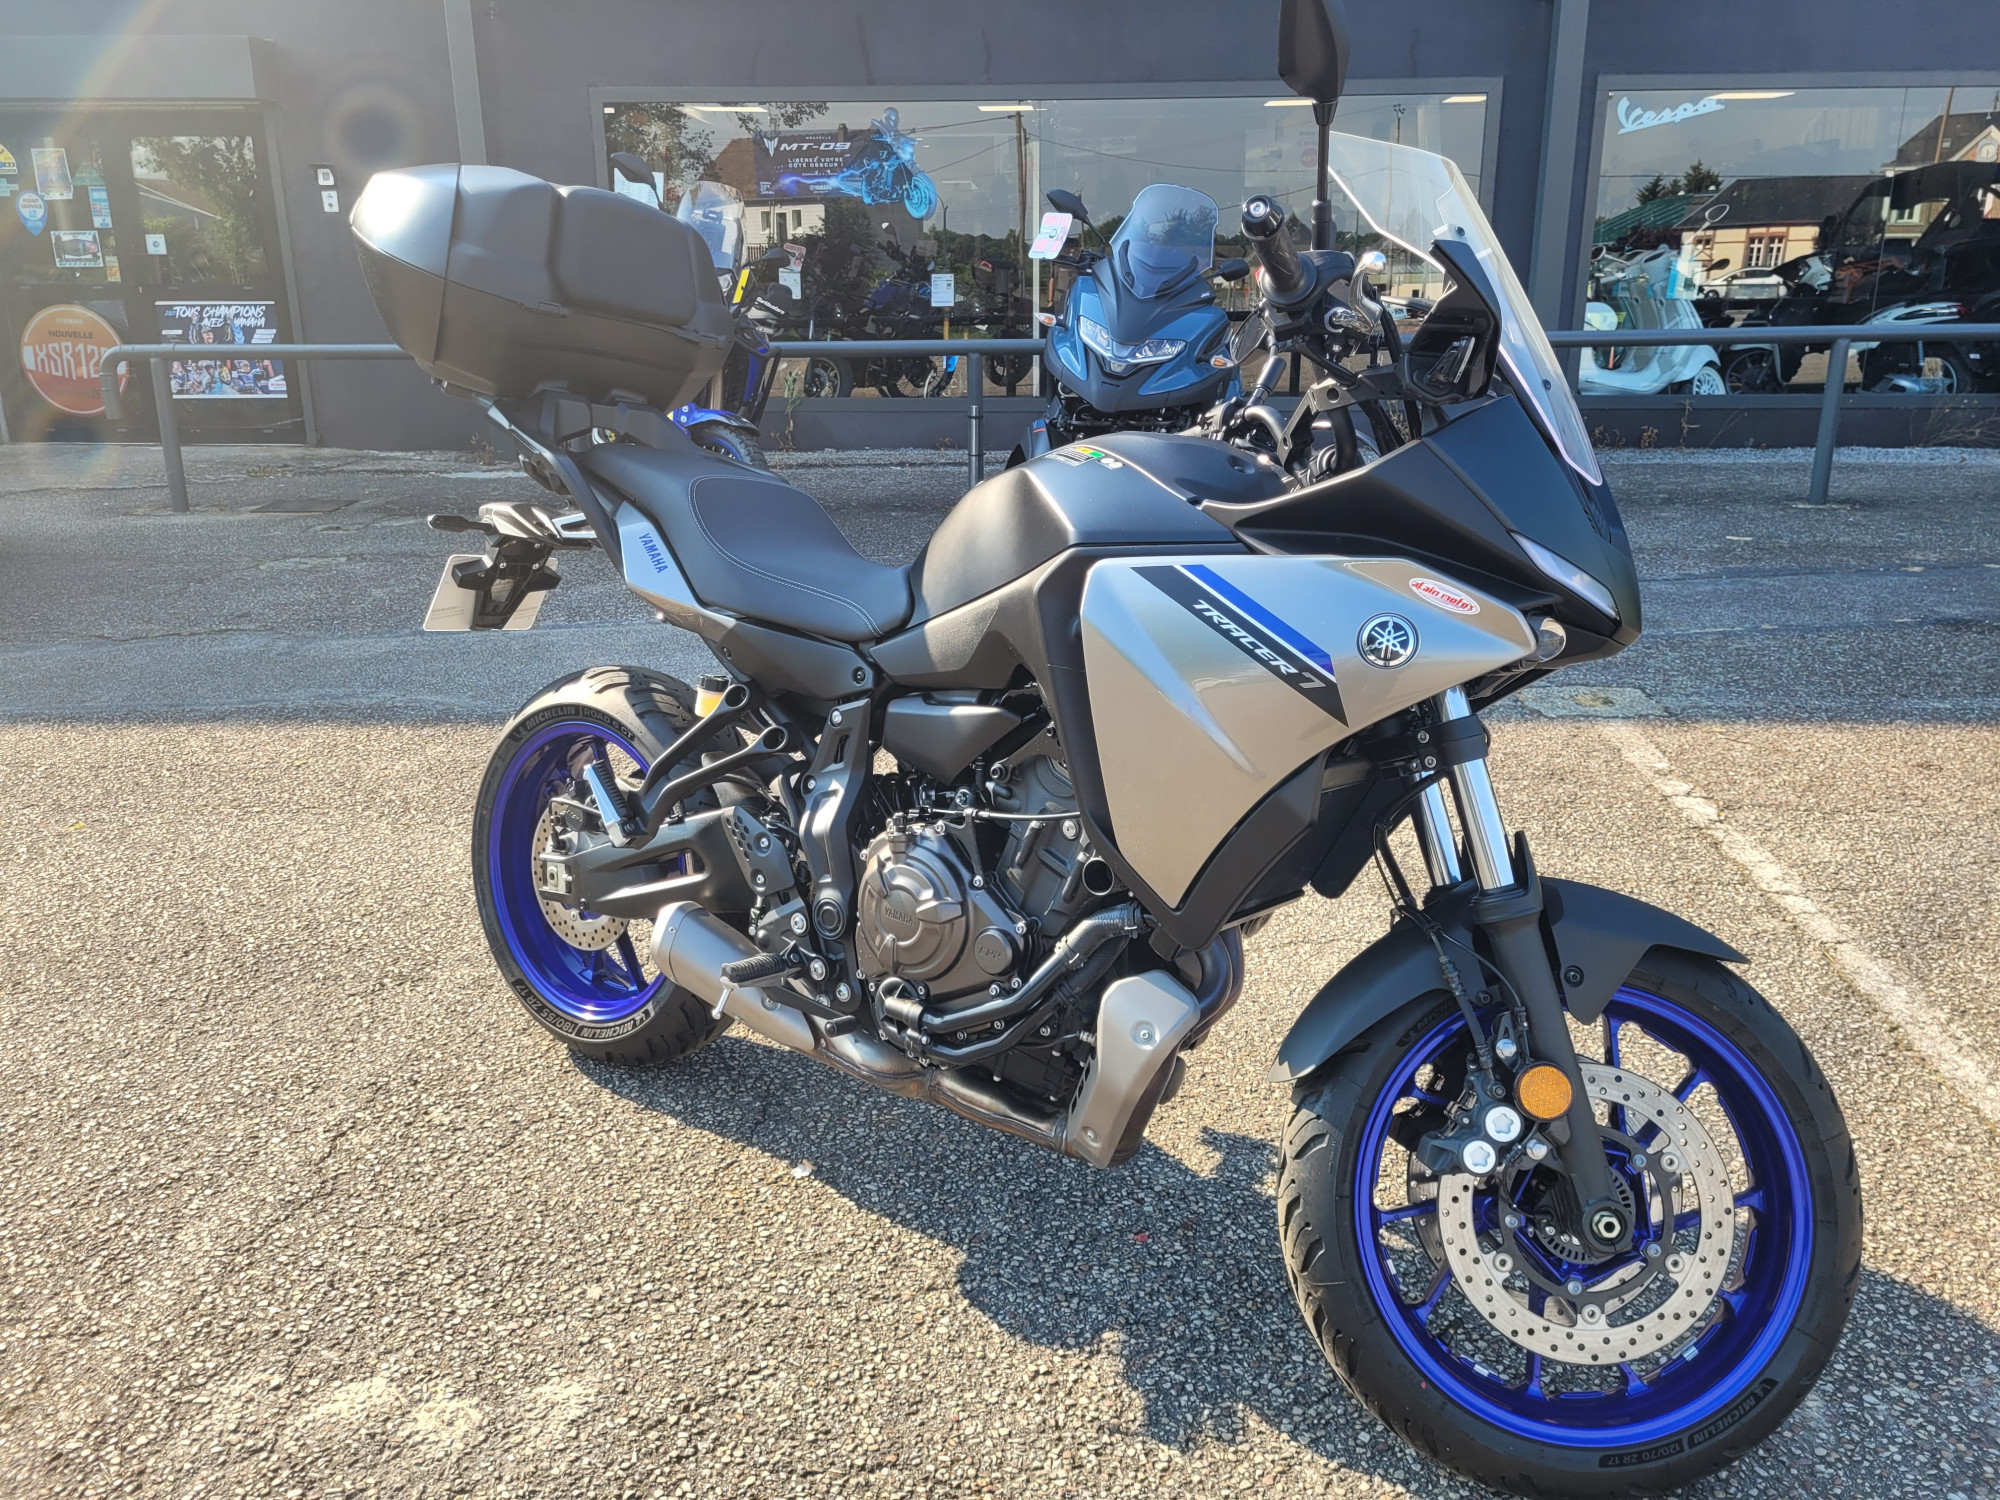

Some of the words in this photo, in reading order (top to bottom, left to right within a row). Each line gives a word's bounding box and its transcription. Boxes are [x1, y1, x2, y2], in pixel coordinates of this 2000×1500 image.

[1617, 96, 1726, 135] Vespa
[780, 142, 851, 151] MT-09
[173, 305, 201, 319] TOUS
[202, 304, 266, 318] CHAMPIONS
[48, 330, 95, 339] NOUVELLE
[638, 532, 669, 574] YAMAHA
[1192, 599, 1300, 676] TRACER
[525, 705, 576, 730] MICHELIN
[583, 708, 612, 724] ROAD
[611, 719, 620, 729] 6
[620, 723, 635, 740] GT
[884, 906, 913, 926] YAMAHA
[525, 995, 544, 1012] ZR
[539, 1010, 577, 1034] 180/55
[579, 1019, 634, 1039] MICHELIN
[1693, 1396, 1757, 1444] MICHELIN
[1607, 1456, 1621, 1466] 17
[1622, 1454, 1639, 1465] ZR
[1641, 1441, 1682, 1461] 120/70
